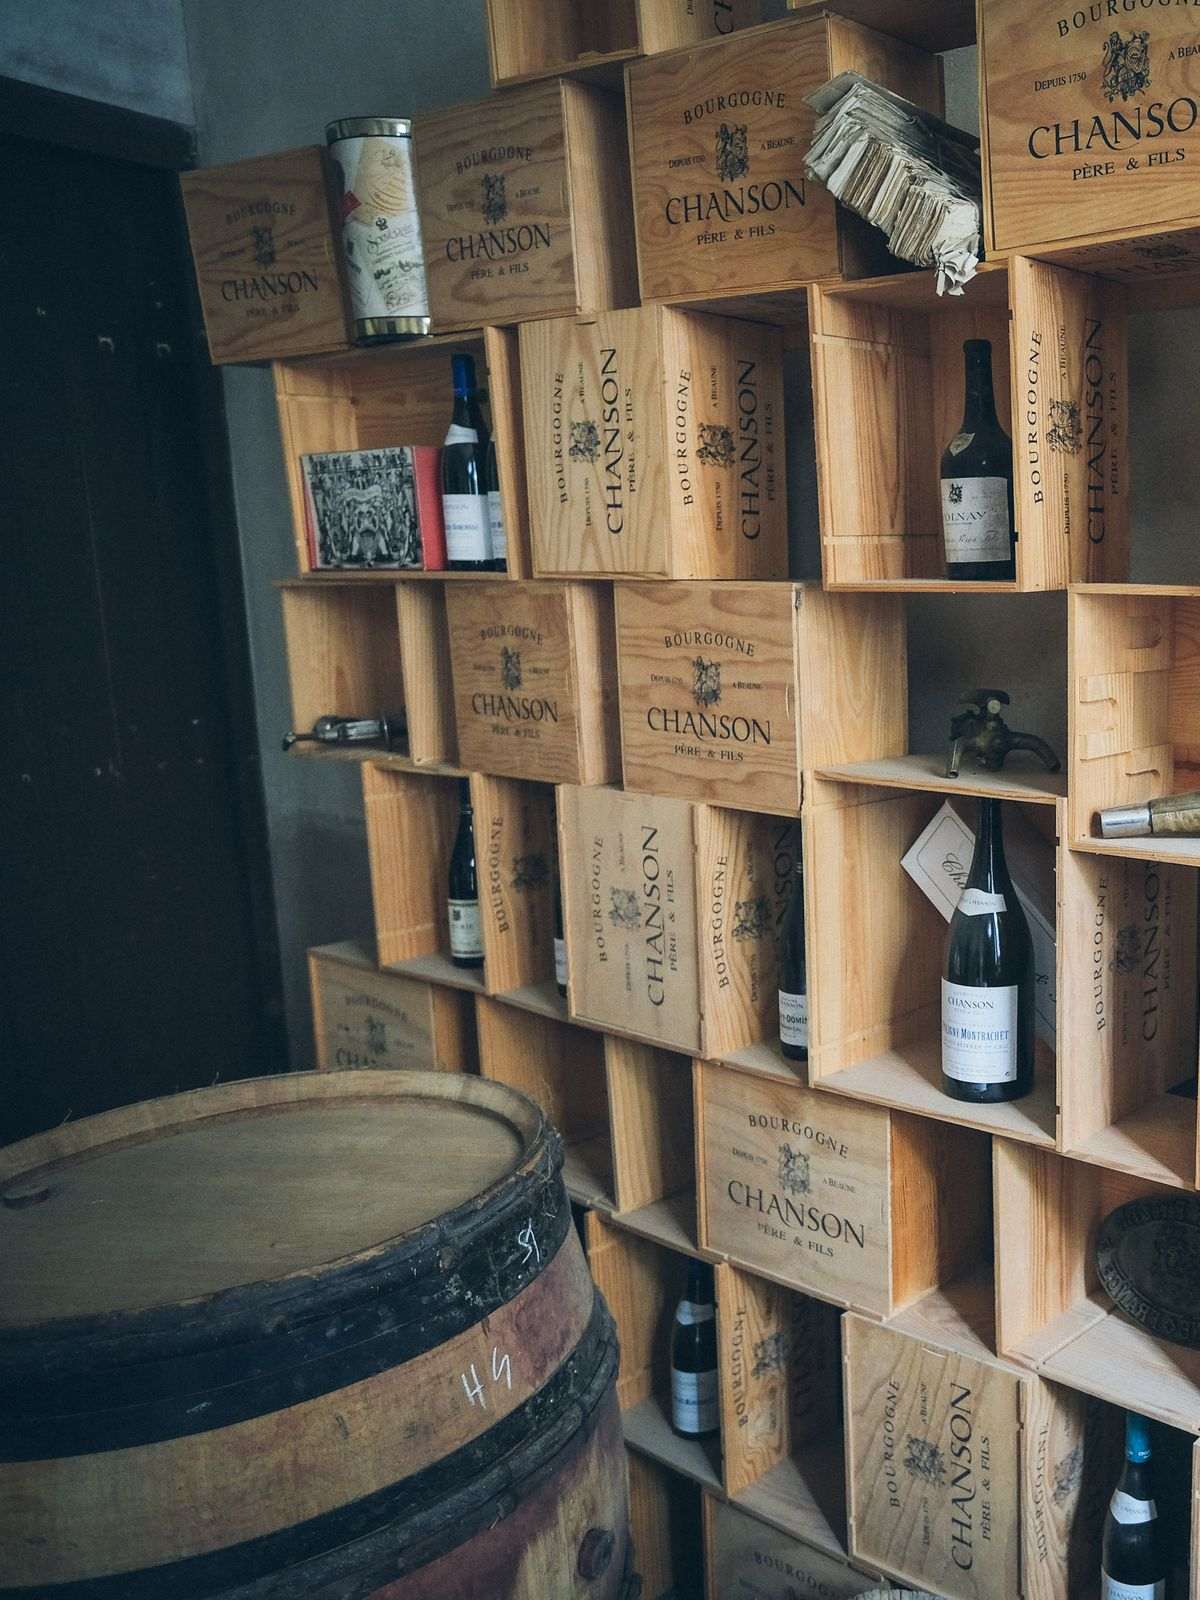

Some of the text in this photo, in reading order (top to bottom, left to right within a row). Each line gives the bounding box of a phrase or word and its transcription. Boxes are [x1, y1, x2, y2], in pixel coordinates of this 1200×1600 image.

[1034, 71, 1087, 92] DEPUIS 1750
[683, 91, 786, 125] BOURGOGNE
[456, 147, 532, 175] BOURGOGNE
[1072, 148, 1186, 181] PÈRE & FILS
[665, 178, 808, 225] CHANSON
[446, 223, 551, 262] CHANSON
[696, 223, 776, 245] PÈRE & FILS
[221, 270, 319, 301] CHANSON
[625, 387, 633, 422] FILS
[1026, 330, 1044, 506] BOURGOGNE
[553, 372, 568, 504] BOURGOGNE
[600, 348, 624, 534] CHANSON
[627, 431, 635, 443] &
[675, 369, 694, 506] BOURGOGNE
[738, 359, 761, 541] CHANSON
[1086, 318, 1106, 545] CHANSON
[480, 625, 545, 646] BOURGOGNE
[664, 631, 756, 657] BOURGOGNE
[471, 692, 559, 723] CHANSON
[646, 706, 772, 745] CHANSON
[674, 742, 745, 762] PÈRE & FILS
[489, 815, 511, 934] BOURGOGNE
[666, 869, 675, 904] FILS
[591, 835, 609, 963] BOURGOGNE
[641, 825, 665, 1008] CHANSON
[711, 855, 730, 989] BOURGOGNE
[1093, 876, 1107, 1031] BOURGOGNE
[1142, 861, 1161, 1042] CHANSO
[947, 996, 995, 1010] CHANSON
[960, 1027, 1009, 1041] MONTRACHET
[748, 1113, 849, 1160] BOURGOGNE
[727, 1179, 866, 1249] CHANSON
[757, 1222, 835, 1258] PÈRE & FILS
[883, 1379, 901, 1509] BOURGOGNE
[950, 1382, 977, 1571] CHANSON
[978, 1435, 993, 1542] PÈRE & FILS
